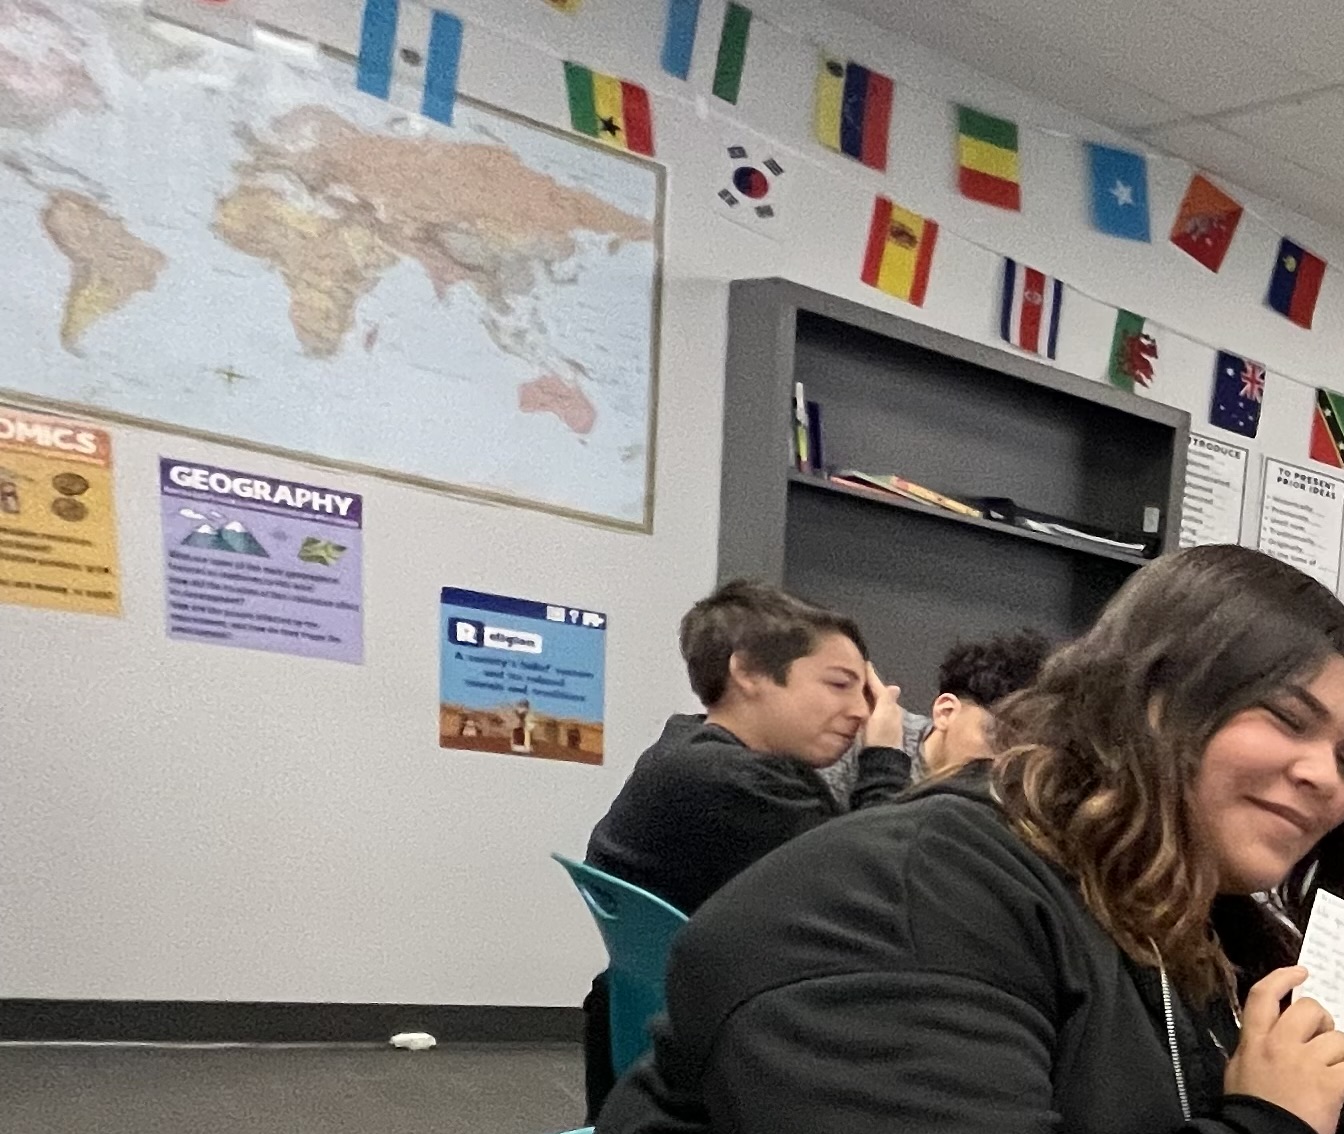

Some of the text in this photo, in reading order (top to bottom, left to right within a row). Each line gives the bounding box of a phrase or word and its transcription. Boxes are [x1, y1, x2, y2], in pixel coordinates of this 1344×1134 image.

[1276, 476, 1336, 499] PRIOR IDEAS
[1279, 467, 1336, 489] TO PRESENT
[169, 465, 354, 516] GEOGRAPHY
